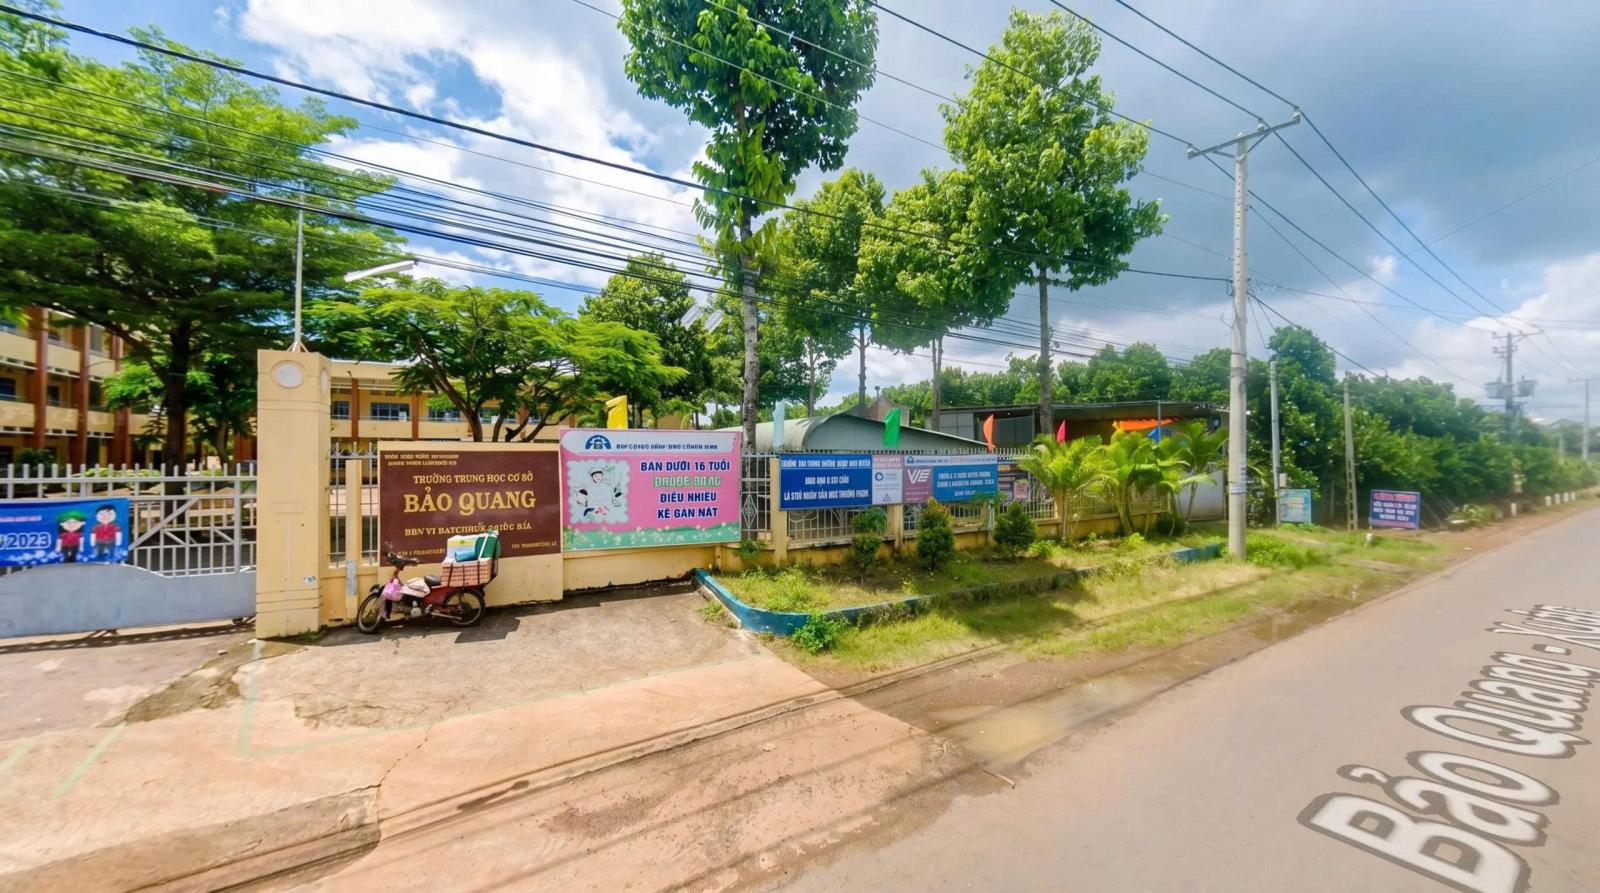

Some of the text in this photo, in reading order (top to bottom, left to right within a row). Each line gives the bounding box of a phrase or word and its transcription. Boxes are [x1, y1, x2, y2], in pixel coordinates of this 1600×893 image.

[694, 461, 706, 471] 16
[413, 470, 534, 484] TRƯỜNG TRUNG HỌC CƠ SỞ
[403, 487, 537, 516] BẢO QUANG
[6, 532, 51, 549] 2023
